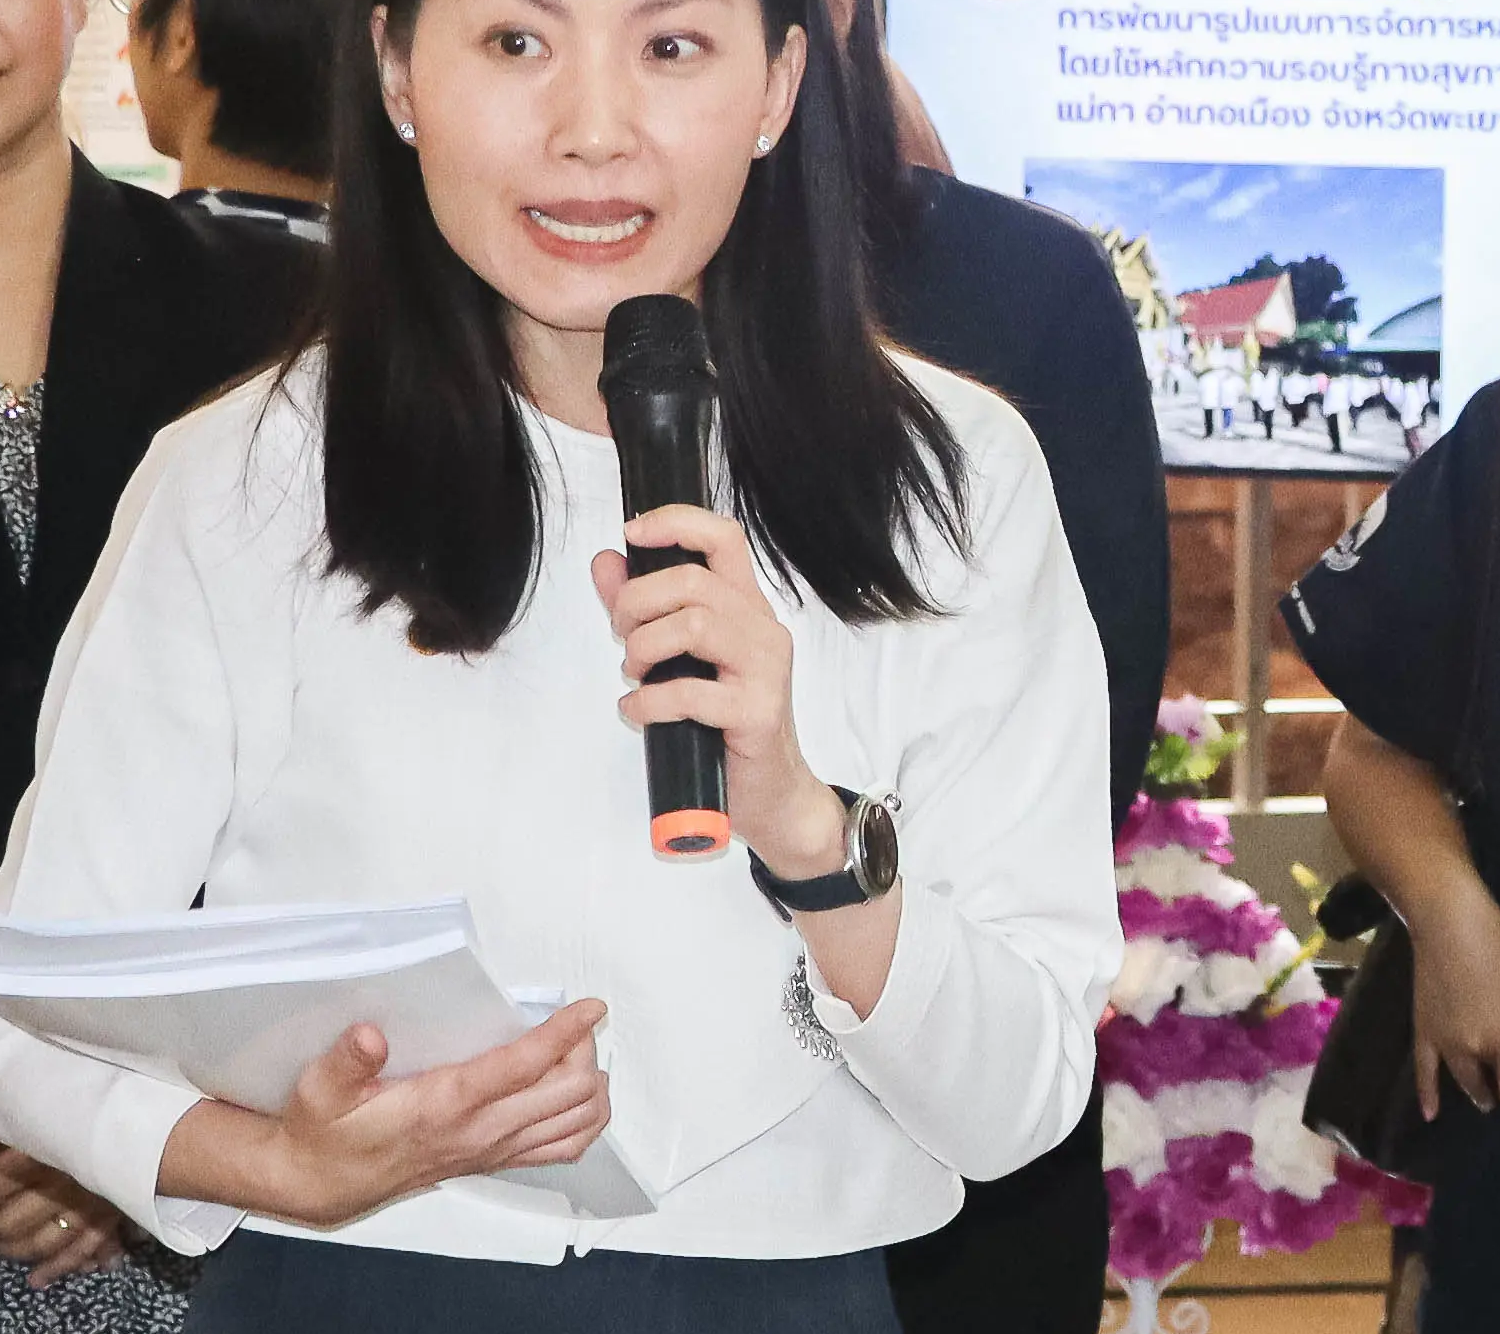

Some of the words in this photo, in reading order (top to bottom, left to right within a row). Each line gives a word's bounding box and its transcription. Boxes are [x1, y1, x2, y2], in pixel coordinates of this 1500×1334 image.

[1057, 98, 1134, 127] แม่กา
[1146, 97, 1311, 129] อำเภอเมือง
